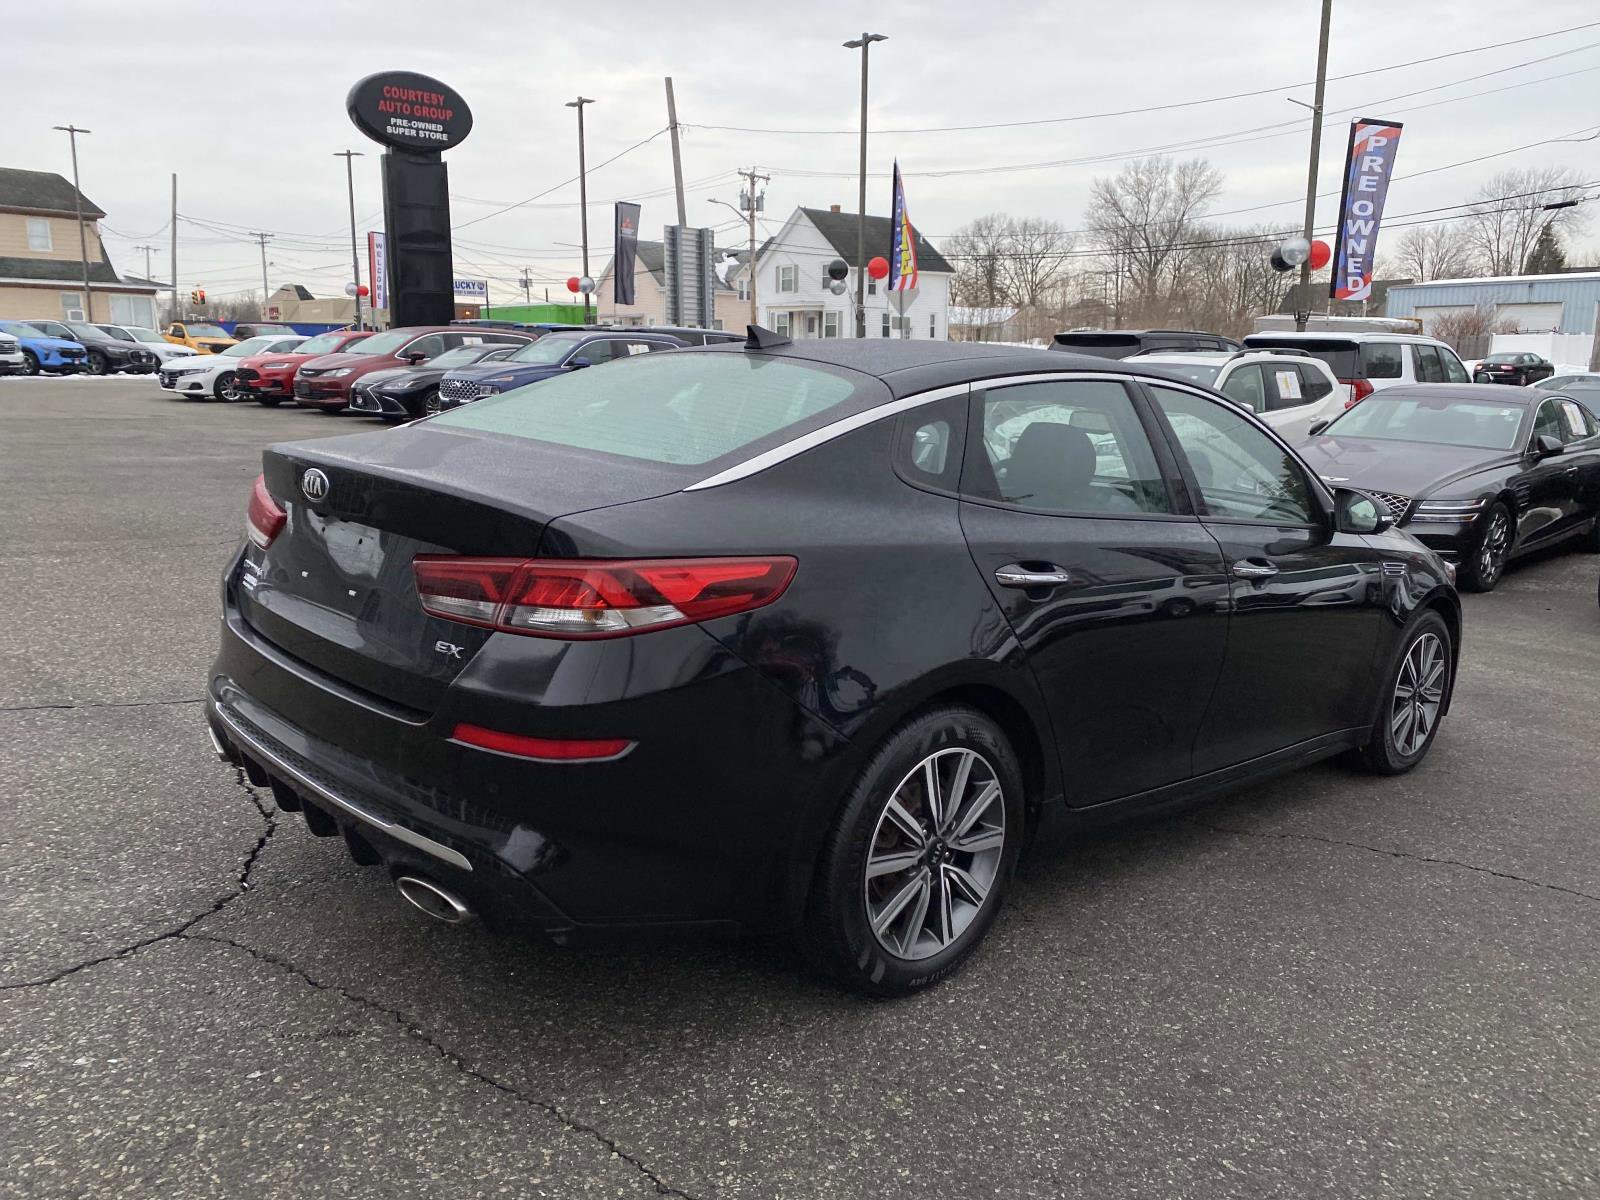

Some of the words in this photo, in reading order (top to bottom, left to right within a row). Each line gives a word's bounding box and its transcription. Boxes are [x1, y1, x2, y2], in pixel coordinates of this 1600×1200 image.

[383, 86, 445, 106] COURTESY
[378, 100, 410, 114] AUTO
[413, 105, 453, 120] GROUP
[386, 126, 416, 137] SUPER
[418, 130, 448, 140] STORE
[390, 117, 443, 132] PRE-OWNED
[1358, 135, 1388, 192] PRE
[1347, 200, 1375, 292] OWNED
[304, 475, 322, 496] KIA
[435, 640, 465, 659] EX
